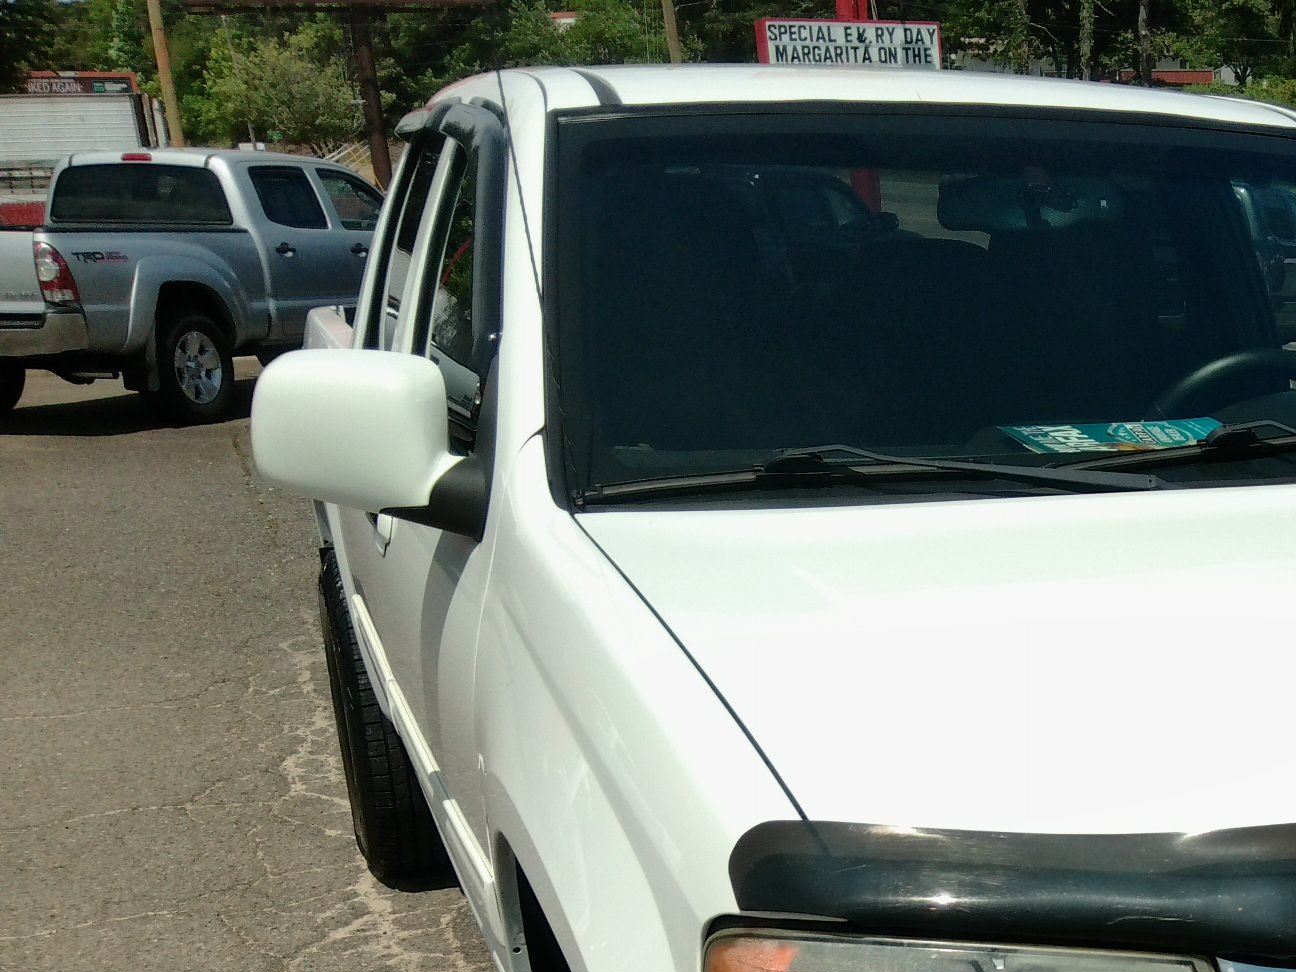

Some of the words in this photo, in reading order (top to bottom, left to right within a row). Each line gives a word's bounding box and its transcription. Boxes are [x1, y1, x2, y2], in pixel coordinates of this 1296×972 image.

[767, 24, 837, 43] SPECIAL
[903, 28, 936, 45] DAY
[775, 44, 872, 64] MARGARITA
[878, 47, 899, 64] ON
[904, 47, 933, 64] THE
